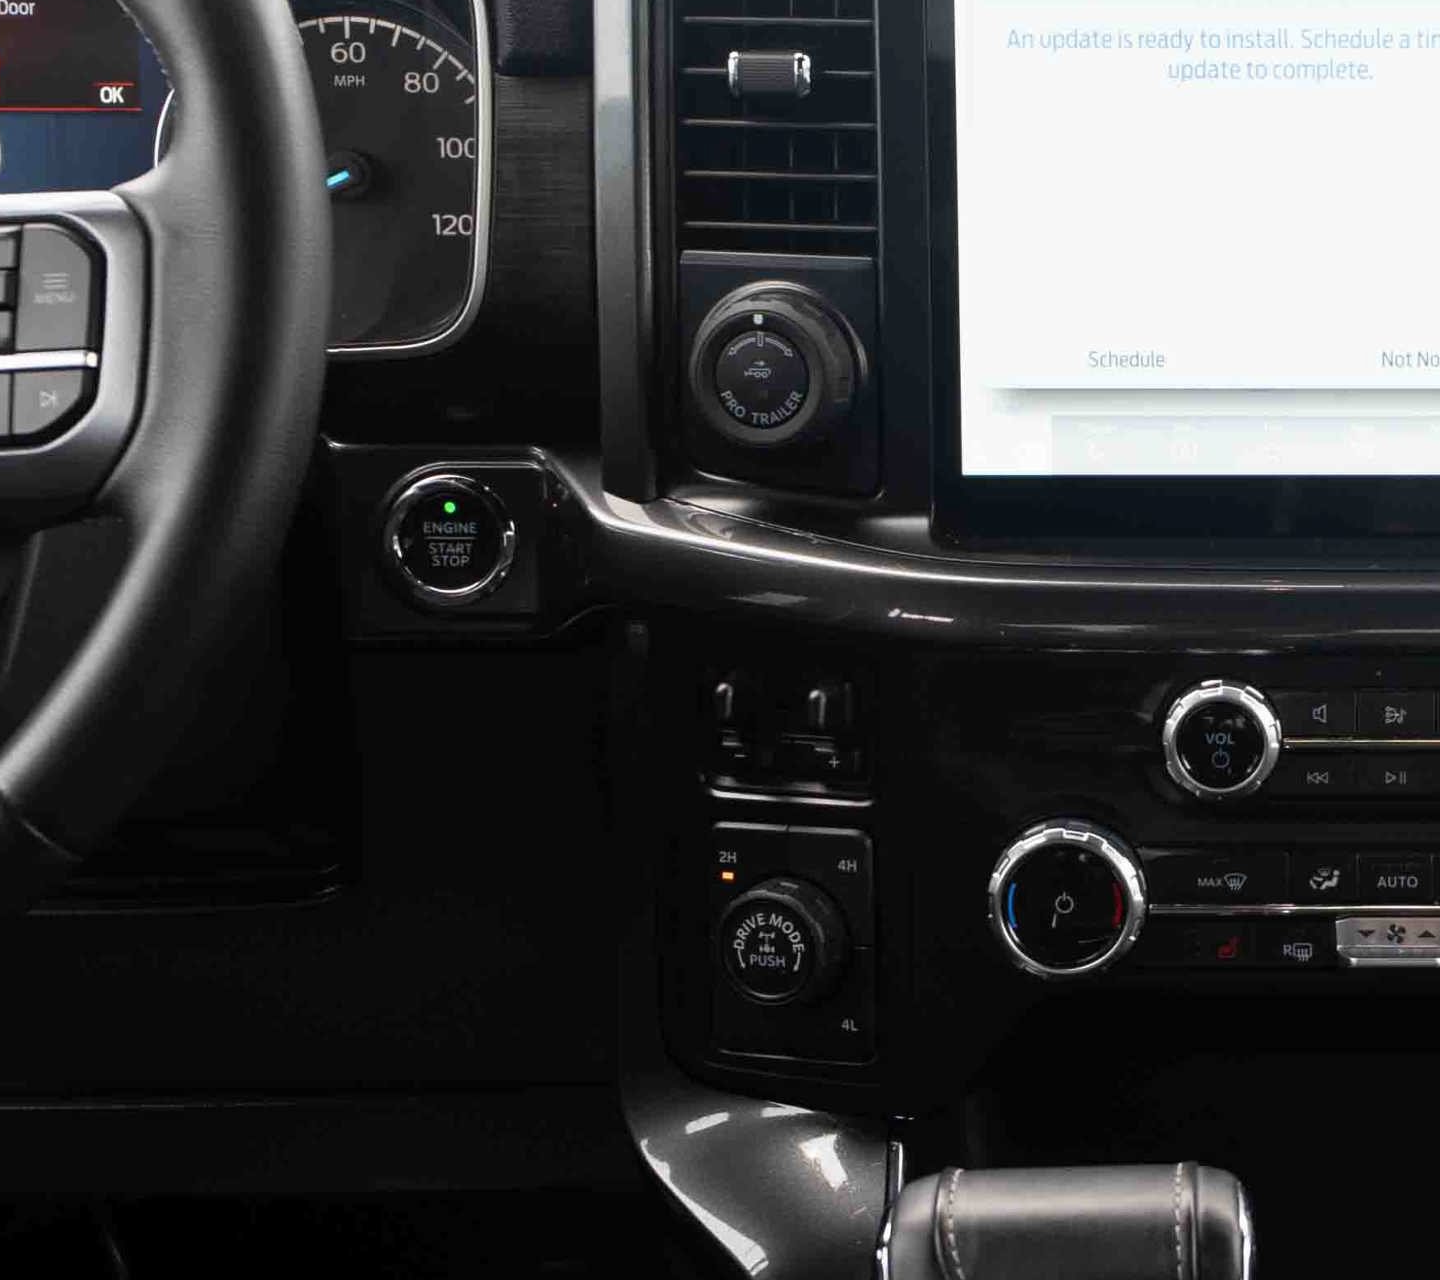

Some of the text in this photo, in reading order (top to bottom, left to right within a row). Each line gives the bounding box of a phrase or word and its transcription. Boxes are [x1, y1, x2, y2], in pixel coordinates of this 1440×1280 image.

[1007, 28, 1034, 49] An
[1039, 28, 1113, 53] update
[1117, 30, 1134, 49] is
[1138, 28, 1194, 53] ready
[1199, 29, 1221, 49] to
[1226, 27, 1294, 49] install.
[1300, 27, 1394, 49] Schedule
[1398, 33, 1411, 49] a
[330, 41, 366, 64] 60
[1167, 58, 1374, 83] update to complete.
[333, 74, 365, 87] MPH
[404, 71, 440, 94] 80
[99, 86, 125, 104] OK
[431, 213, 474, 236] 120
[1088, 350, 1165, 369] Schedule
[1381, 351, 1412, 369] Not
[720, 390, 804, 427] PRO TRAILER
[423, 521, 477, 534] ENGINE
[428, 542, 472, 554] START
[431, 555, 470, 567] STOP
[1205, 732, 1235, 745] VOL
[719, 850, 737, 864] 2H
[837, 859, 857, 873] 4H
[1197, 875, 1223, 887] MAX
[1377, 875, 1419, 889] AUTO
[733, 912, 806, 954] DRIVE MODE
[749, 953, 786, 968] PUSH
[841, 1018, 859, 1032] 4L
